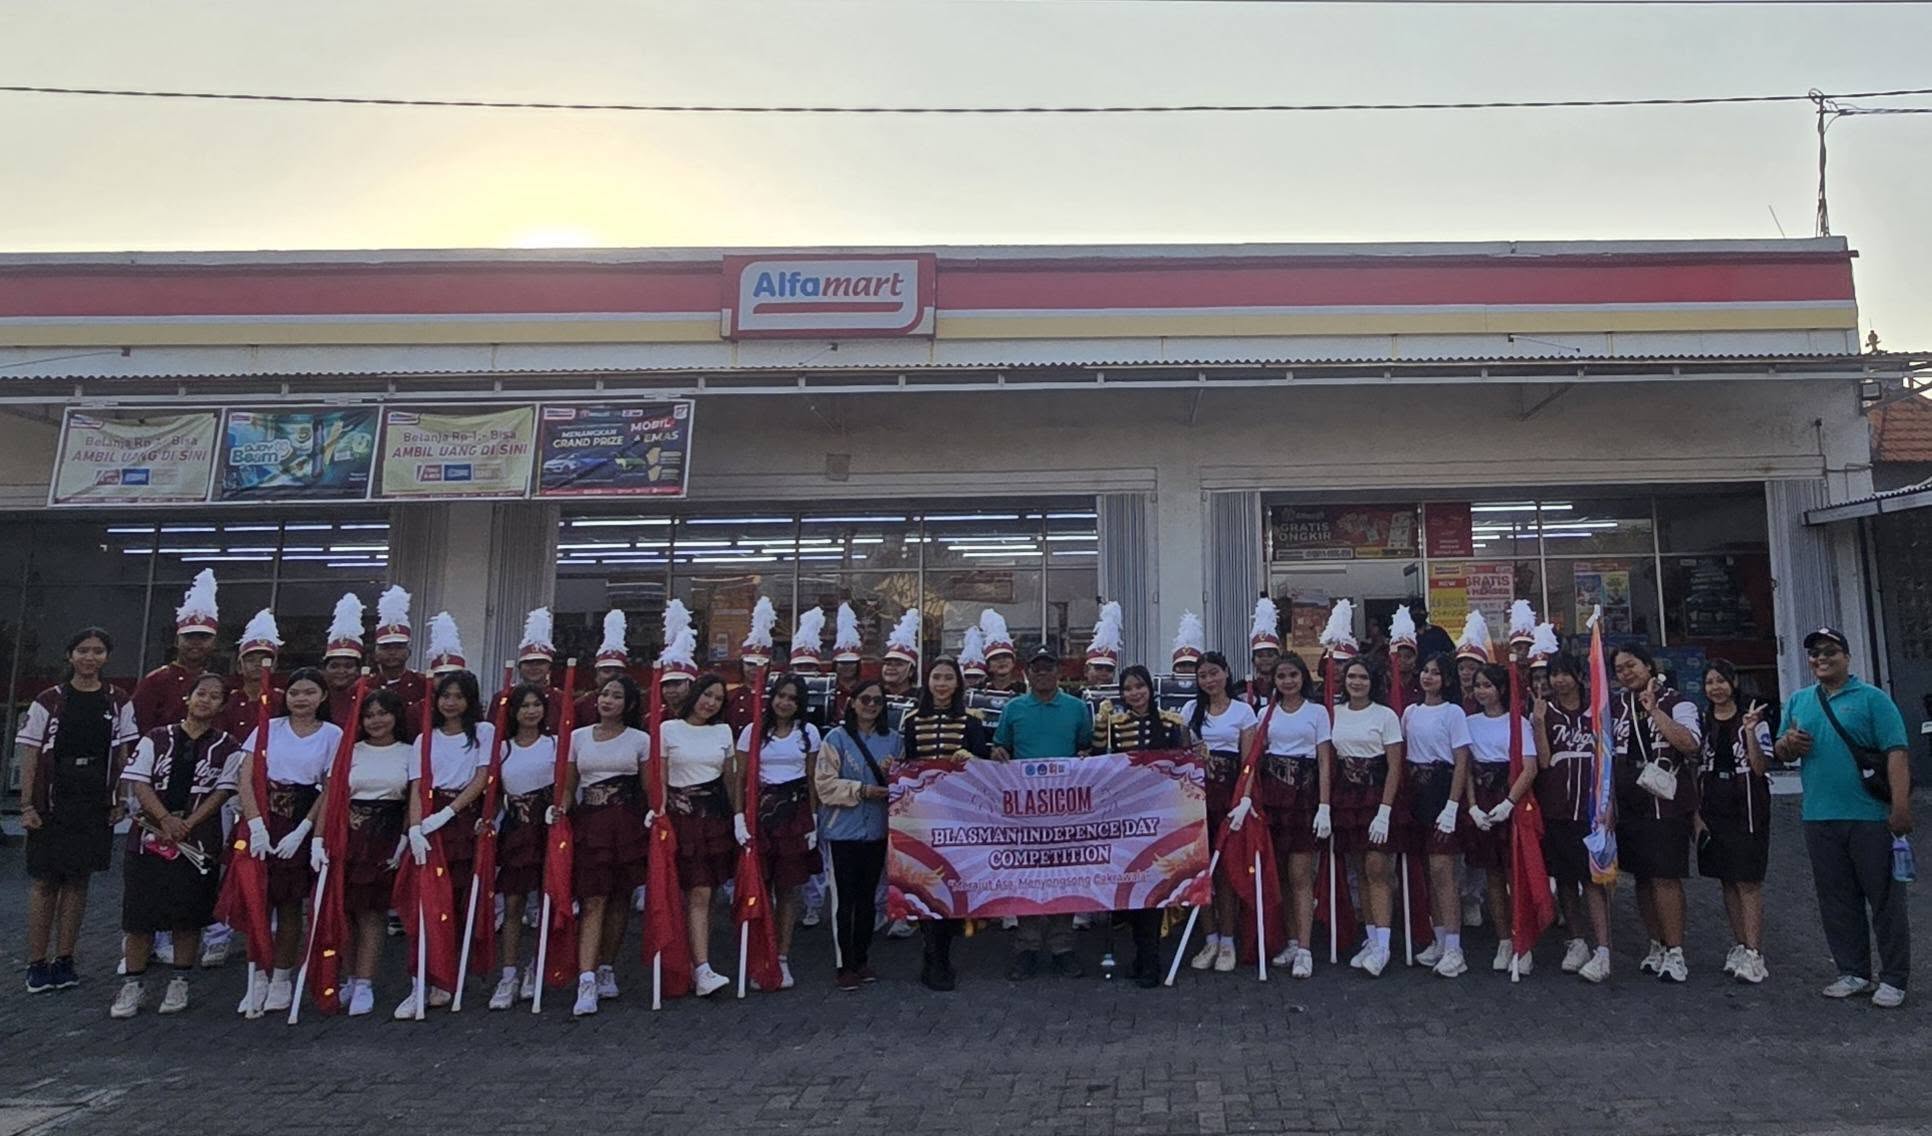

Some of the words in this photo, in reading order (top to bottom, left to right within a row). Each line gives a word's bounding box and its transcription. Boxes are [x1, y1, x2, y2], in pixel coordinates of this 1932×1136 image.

[753, 272, 904, 298] Alfamart
[630, 420, 671, 433] MOBIL
[404, 432, 449, 444] Belanja
[491, 430, 516, 440] Bisa
[561, 429, 617, 438] MENANGKAN
[644, 431, 680, 443] EMAS
[85, 436, 131, 449] Belanja
[553, 437, 591, 448] GRAND
[592, 435, 625, 447] PRIZE
[72, 450, 116, 462] AMBIL
[161, 449, 175, 461] DI
[179, 449, 208, 461] SINI
[392, 446, 433, 458] AMBIL
[439, 445, 477, 457] UANG
[481, 444, 495, 456] DI
[499, 443, 528, 456] SINI
[1280, 522, 1329, 532] GRATIS
[1279, 532, 1331, 541] ONGKIR
[1466, 576, 1510, 588] GRATIS
[1002, 786, 1093, 816] BLASICOM
[933, 828, 1019, 846] BLASMAN
[1022, 822, 1120, 844] INDEPENCE
[1123, 817, 1160, 836] DAY
[989, 845, 1111, 868] COMPETITION
[1019, 875, 1091, 891] Menyongsong
